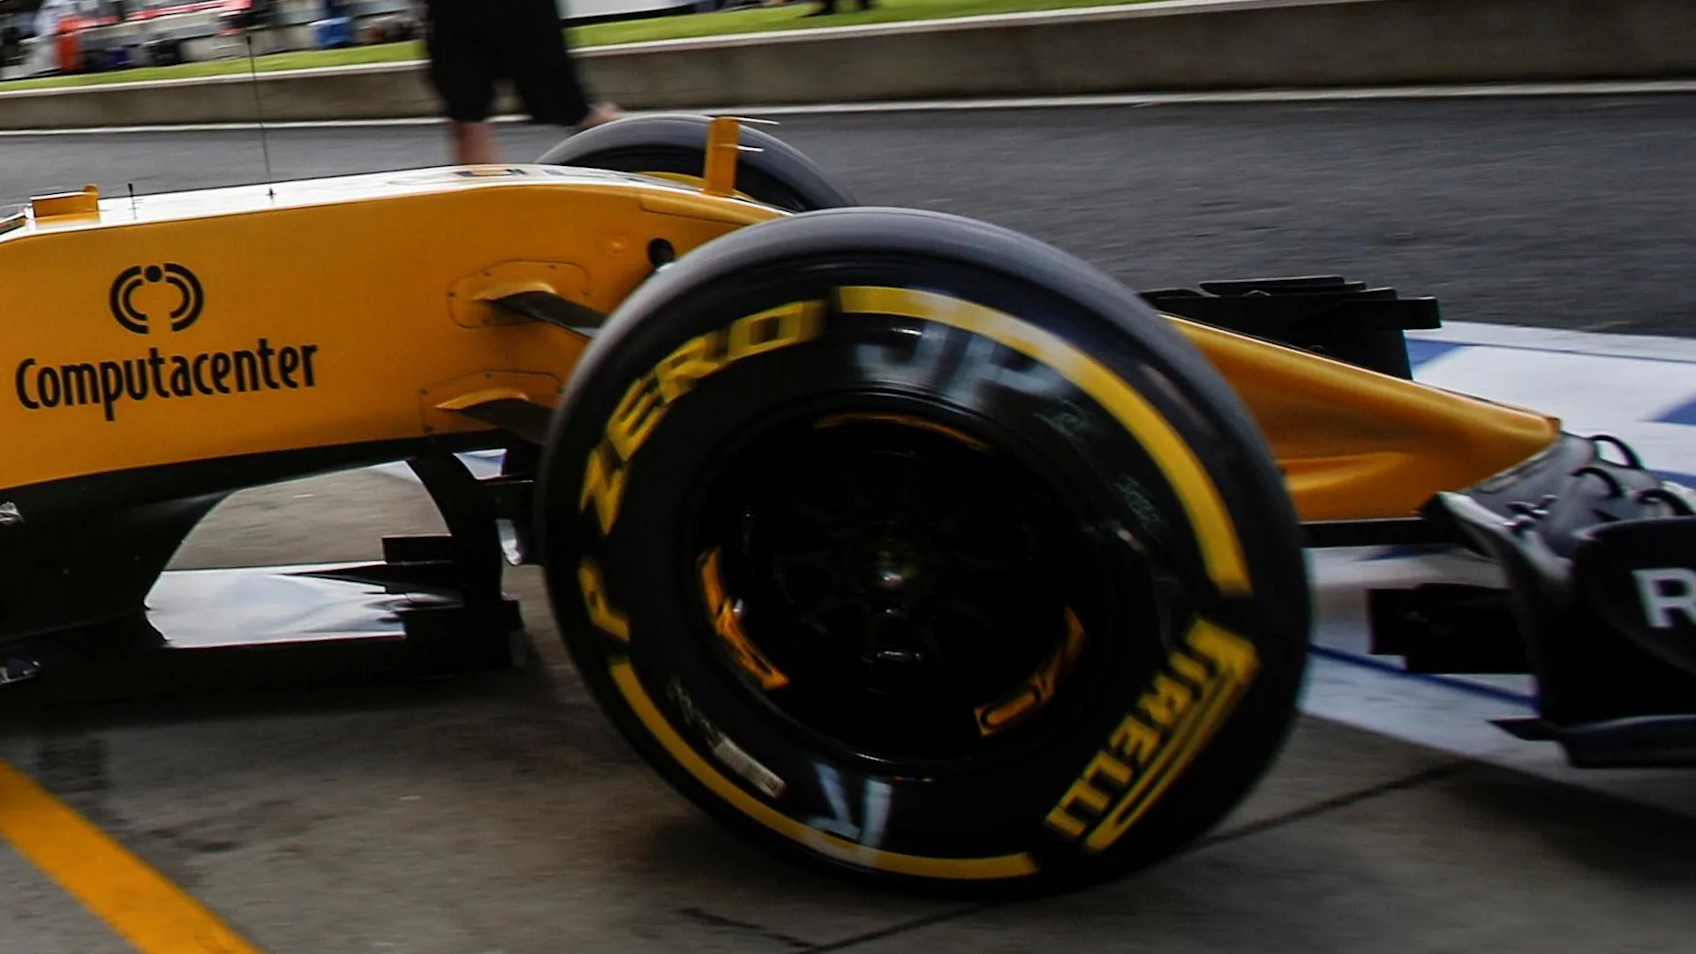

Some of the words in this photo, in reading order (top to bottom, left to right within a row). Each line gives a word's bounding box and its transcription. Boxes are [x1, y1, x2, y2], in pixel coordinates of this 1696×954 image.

[14, 337, 319, 422] Computacenter
[579, 299, 826, 536] ZERO
[1043, 616, 1264, 854] PIRELLI
